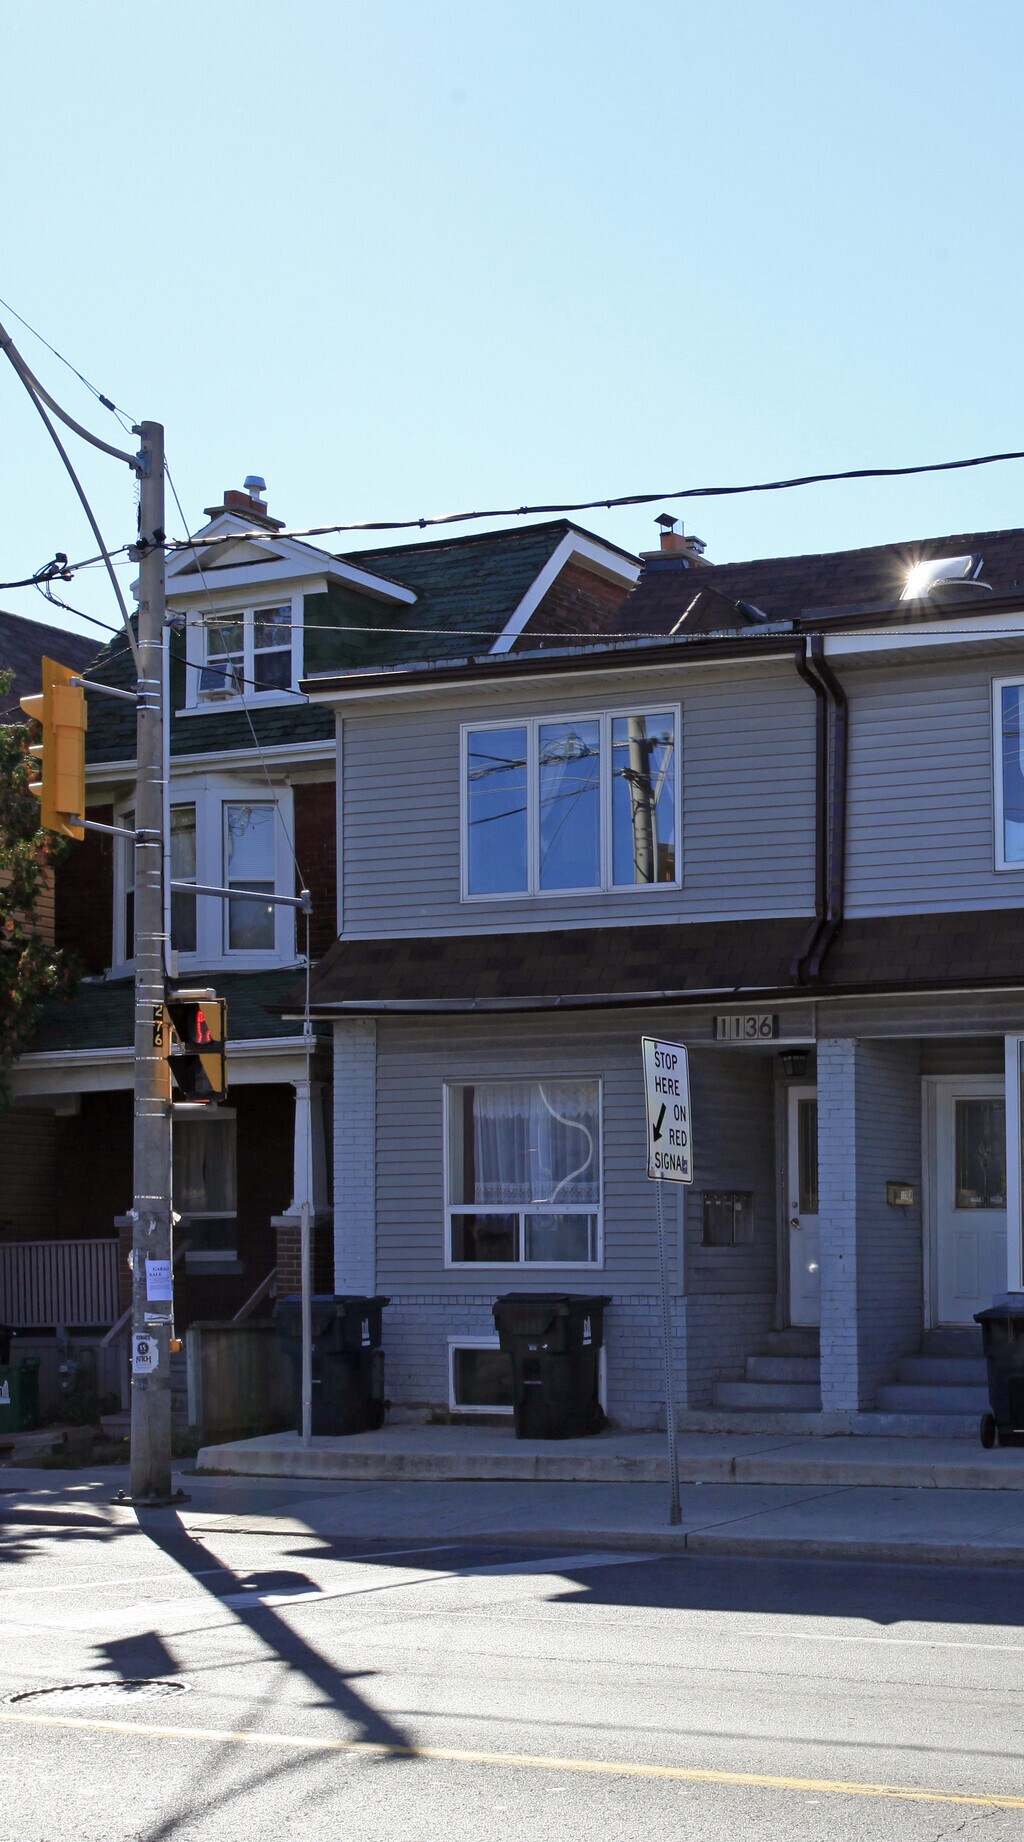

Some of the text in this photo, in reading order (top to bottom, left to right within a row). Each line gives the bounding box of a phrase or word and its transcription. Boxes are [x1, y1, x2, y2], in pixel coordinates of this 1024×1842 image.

[155, 1005, 163, 1046] 276
[721, 1016, 772, 1038] 1136
[654, 1050, 678, 1071] STOP
[654, 1076, 681, 1097] HERE
[673, 1104, 687, 1122] ON
[669, 1128, 688, 1147] RED
